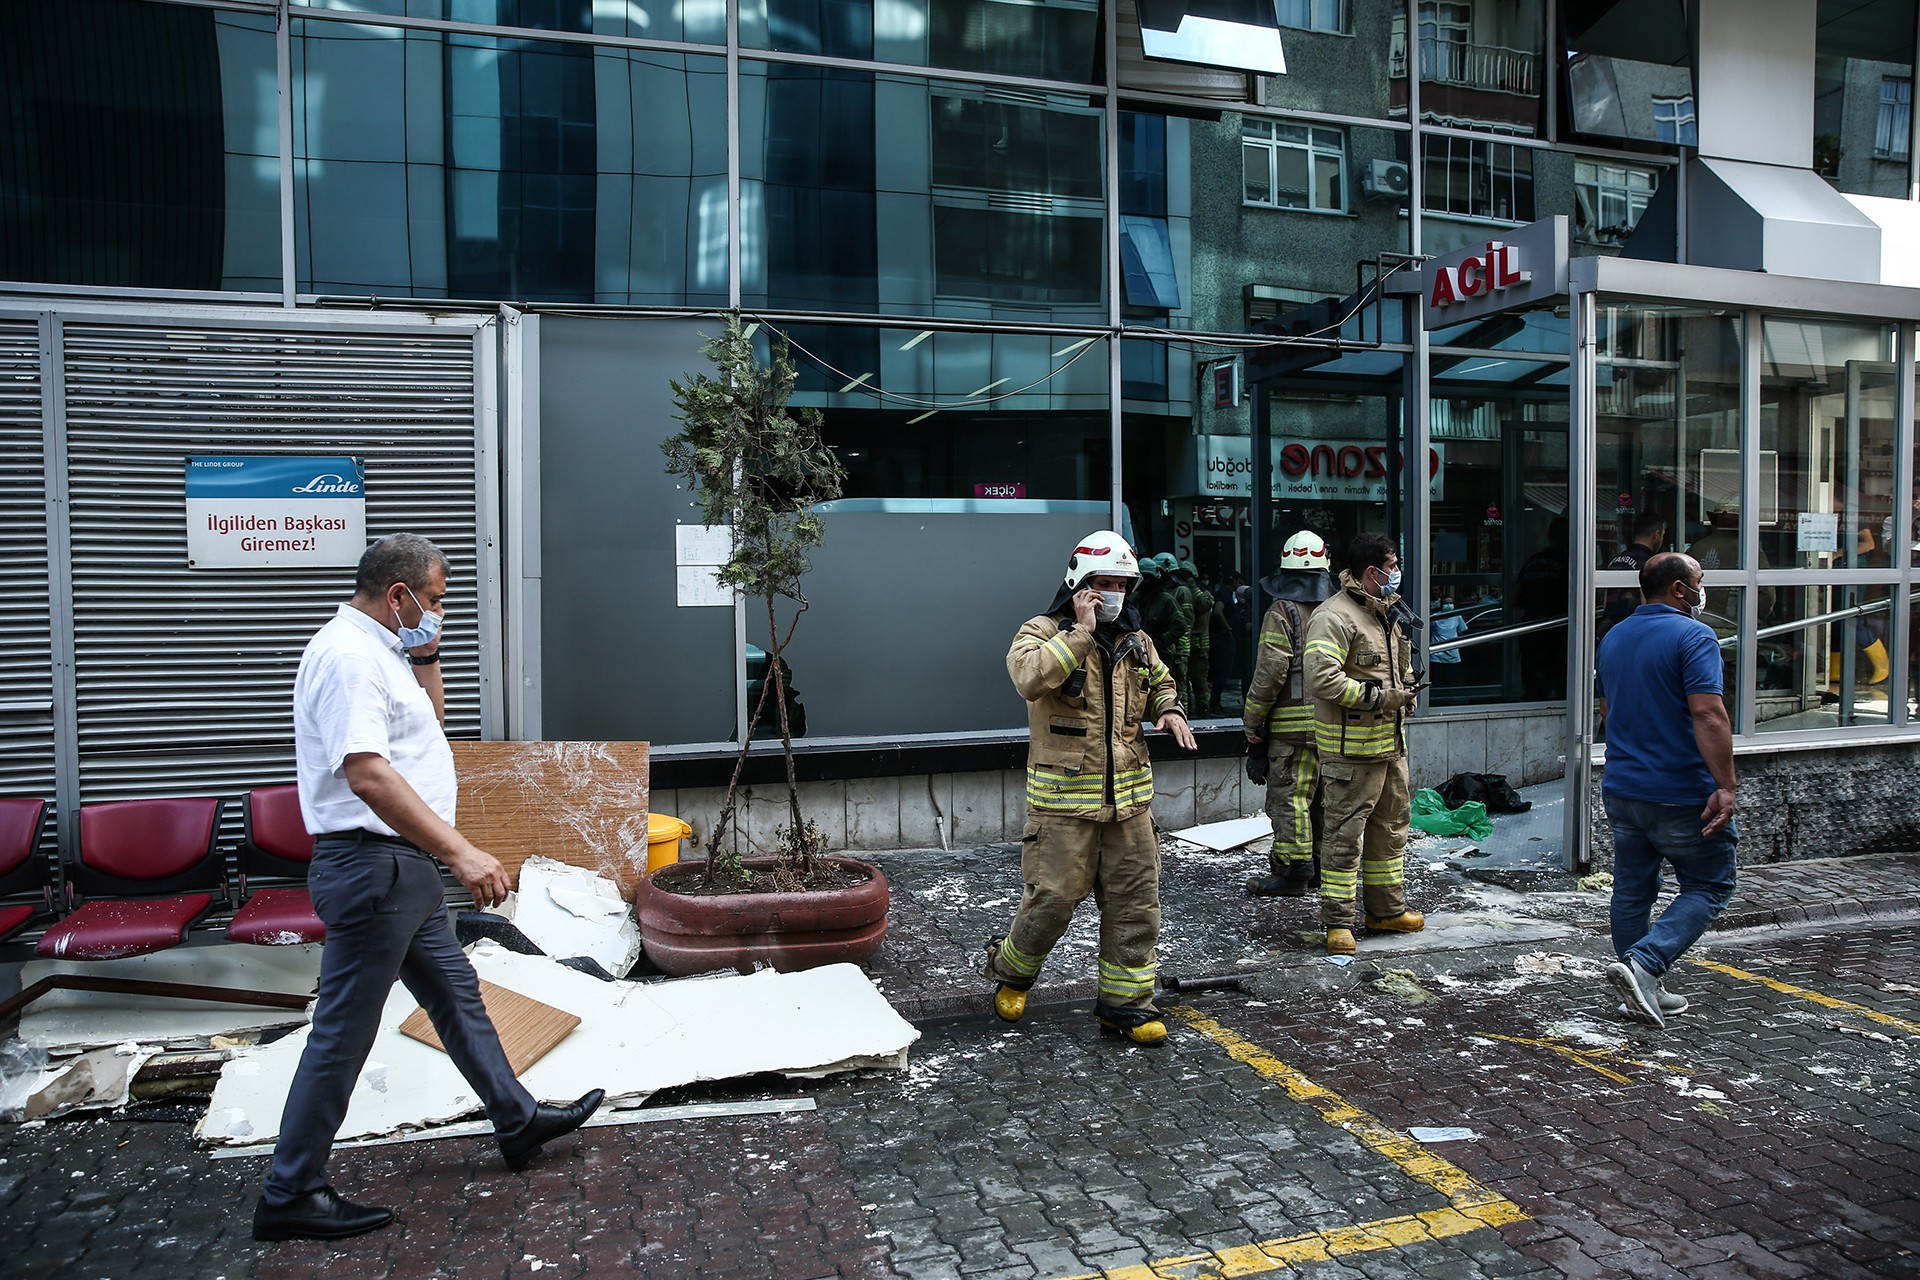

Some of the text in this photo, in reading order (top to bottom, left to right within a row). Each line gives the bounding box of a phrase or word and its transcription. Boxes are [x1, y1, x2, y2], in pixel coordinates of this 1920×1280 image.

[1431, 241, 1530, 308] ACİL
[292, 474, 359, 493] Linde
[207, 514, 346, 534] İlgiliden Başkası
[241, 537, 316, 551] Giremez!
